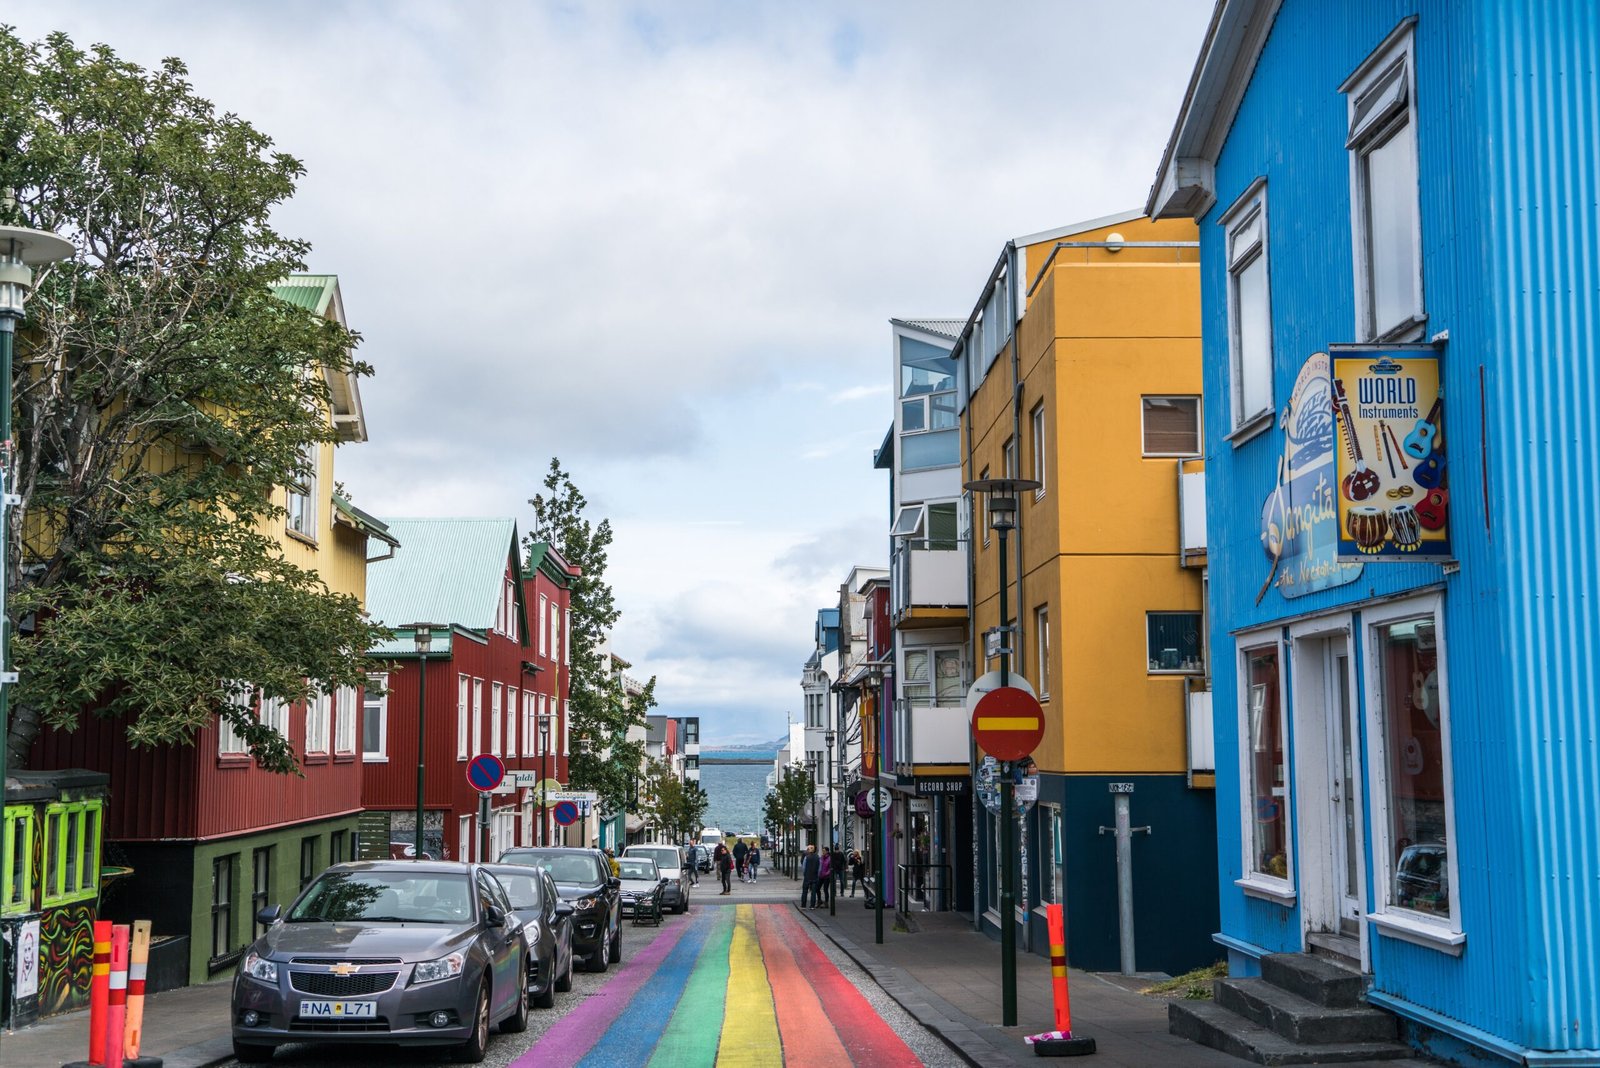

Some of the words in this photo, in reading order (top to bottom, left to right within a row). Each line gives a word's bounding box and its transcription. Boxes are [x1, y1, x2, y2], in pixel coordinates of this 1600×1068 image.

[1358, 377, 1416, 404] WORLD
[1358, 404, 1419, 419] Instruments
[919, 781, 944, 792] RECORD
[946, 781, 963, 791] SHOP
[311, 1002, 332, 1015] NA
[344, 1002, 371, 1015] L71
